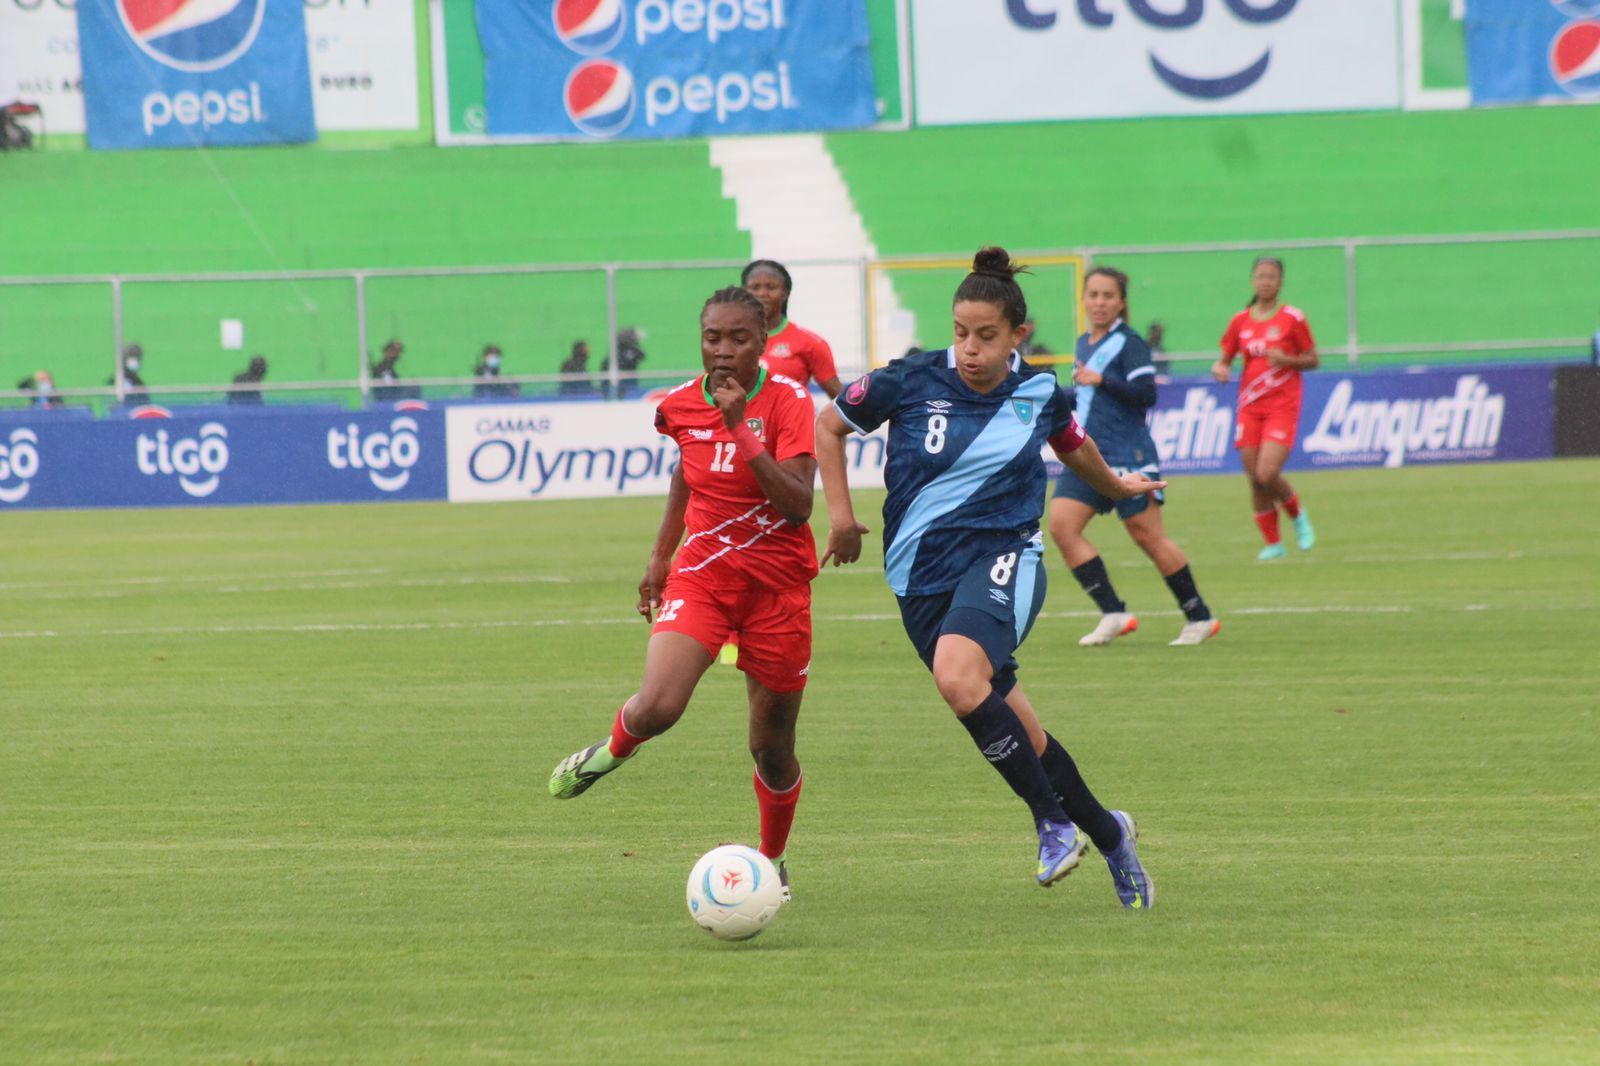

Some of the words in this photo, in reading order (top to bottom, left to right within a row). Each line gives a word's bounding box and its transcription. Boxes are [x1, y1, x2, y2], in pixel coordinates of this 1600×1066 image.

[635, 0, 785, 45] pepsi
[142, 82, 262, 136] pepsi
[645, 61, 791, 127] pepsi
[476, 417, 551, 436] CAMAS
[924, 414, 948, 454] 8
[710, 441, 737, 473] 12
[989, 552, 1017, 586] 8
[656, 599, 685, 623] 12
